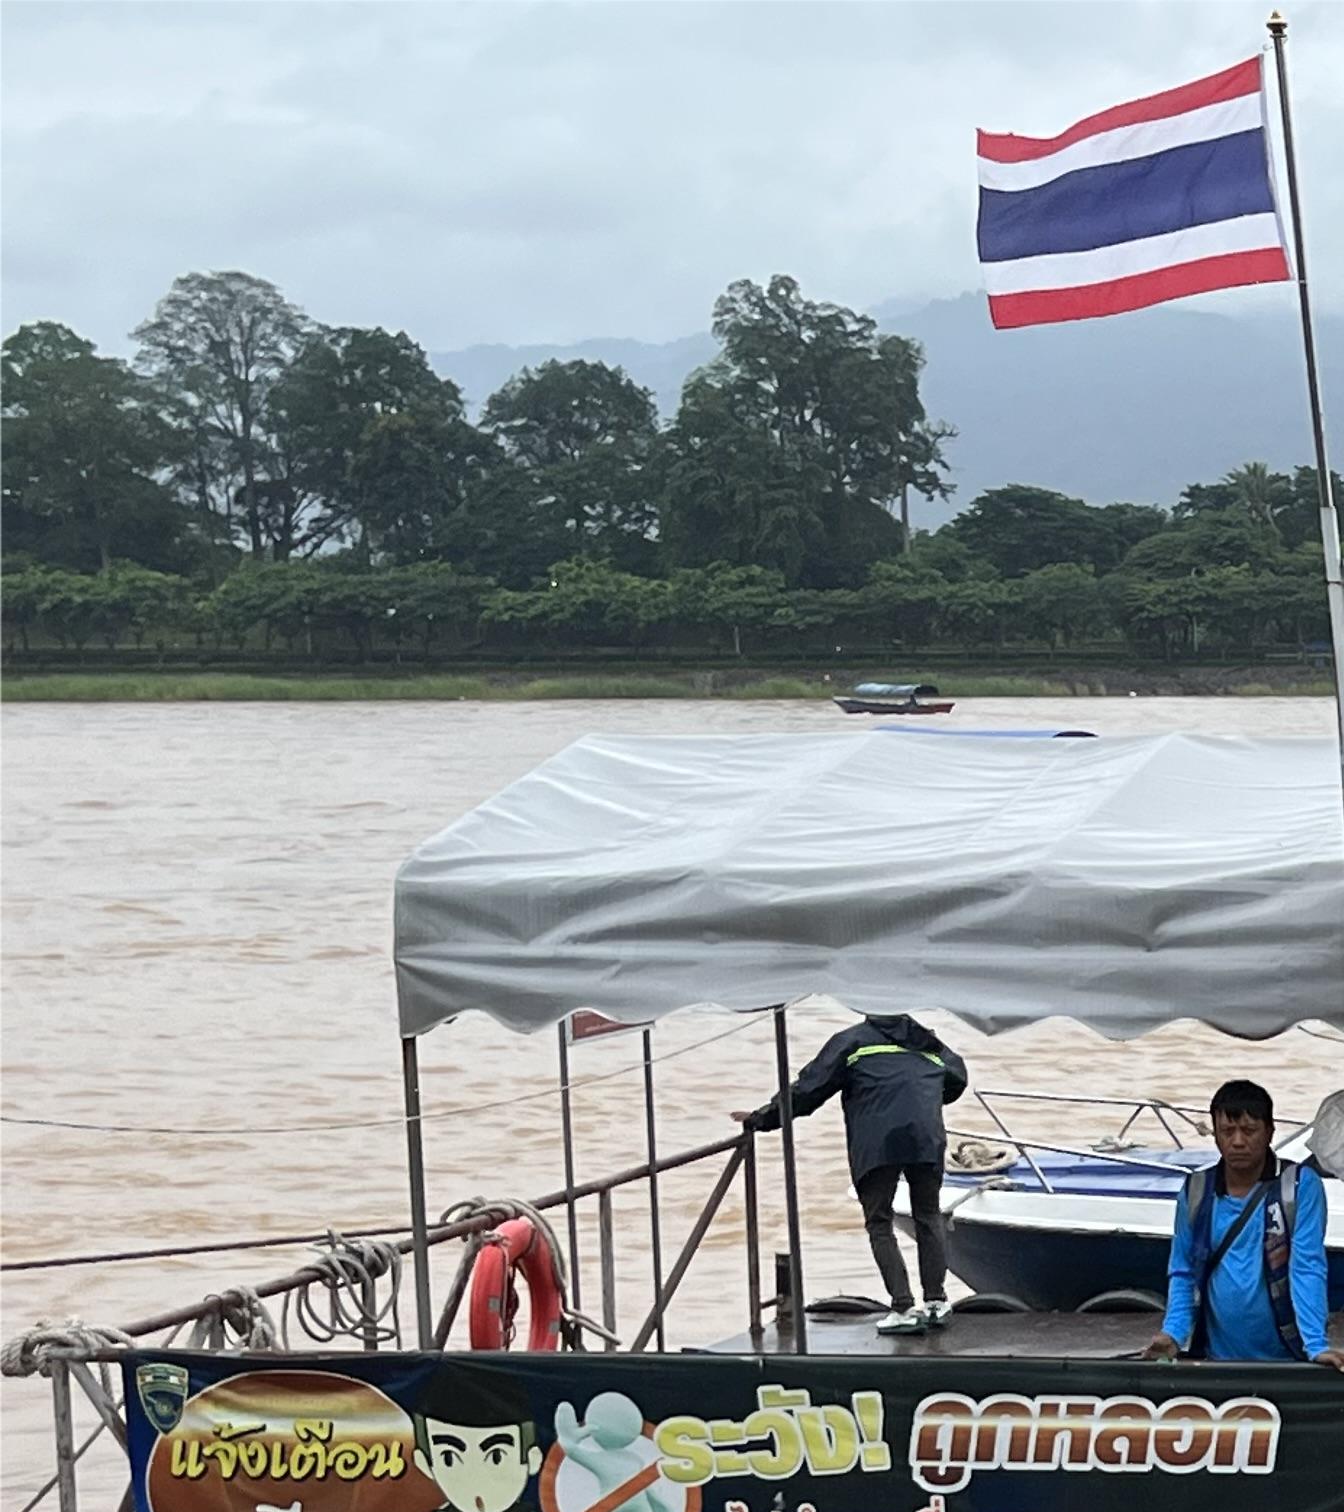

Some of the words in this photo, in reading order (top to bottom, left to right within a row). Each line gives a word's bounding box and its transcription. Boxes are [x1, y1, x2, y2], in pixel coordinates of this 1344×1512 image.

[169, 1420, 405, 1480] แจ้งเตือน
[654, 1385, 893, 1485] ระวัง!
[910, 1393, 1282, 1493] ถูกหลอก
